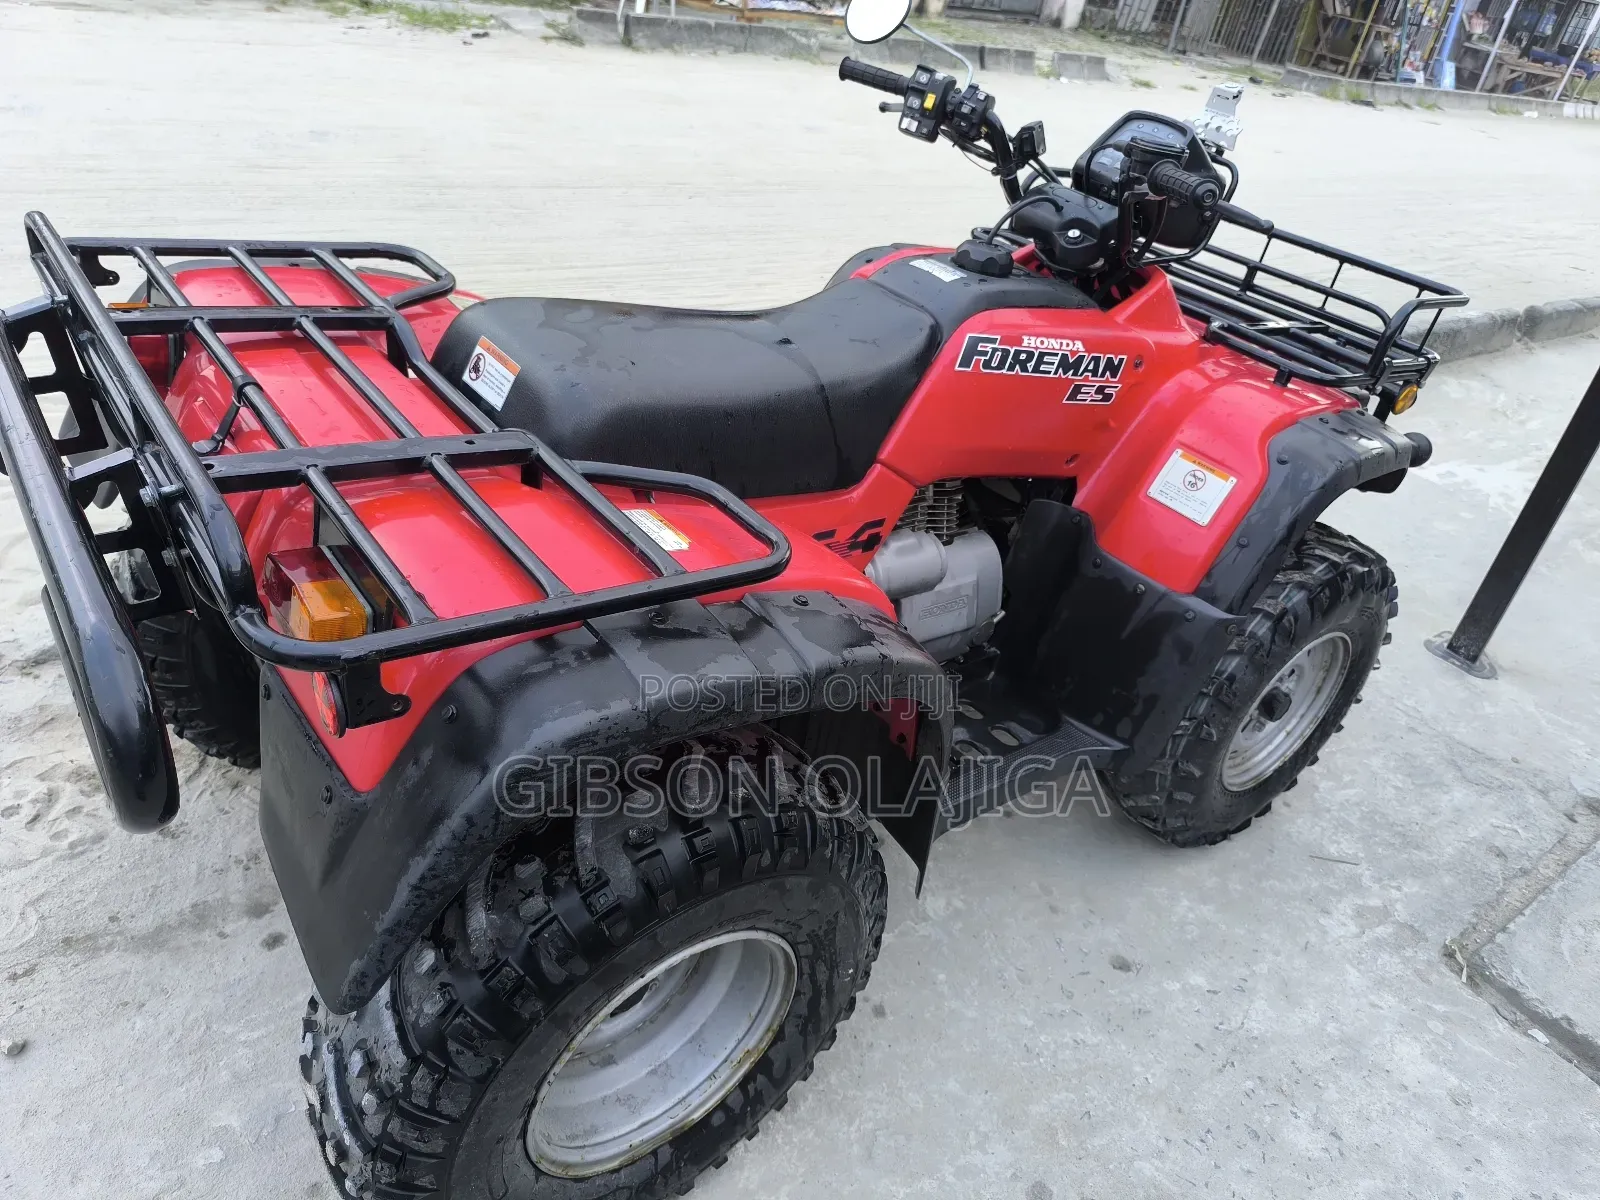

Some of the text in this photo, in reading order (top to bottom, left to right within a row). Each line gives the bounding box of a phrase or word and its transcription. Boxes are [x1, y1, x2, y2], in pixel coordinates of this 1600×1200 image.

[1021, 335, 1086, 351] HONDA
[955, 333, 1128, 381] FOREMAN
[1062, 382, 1122, 404] ES
[920, 597, 968, 618] HONDA
